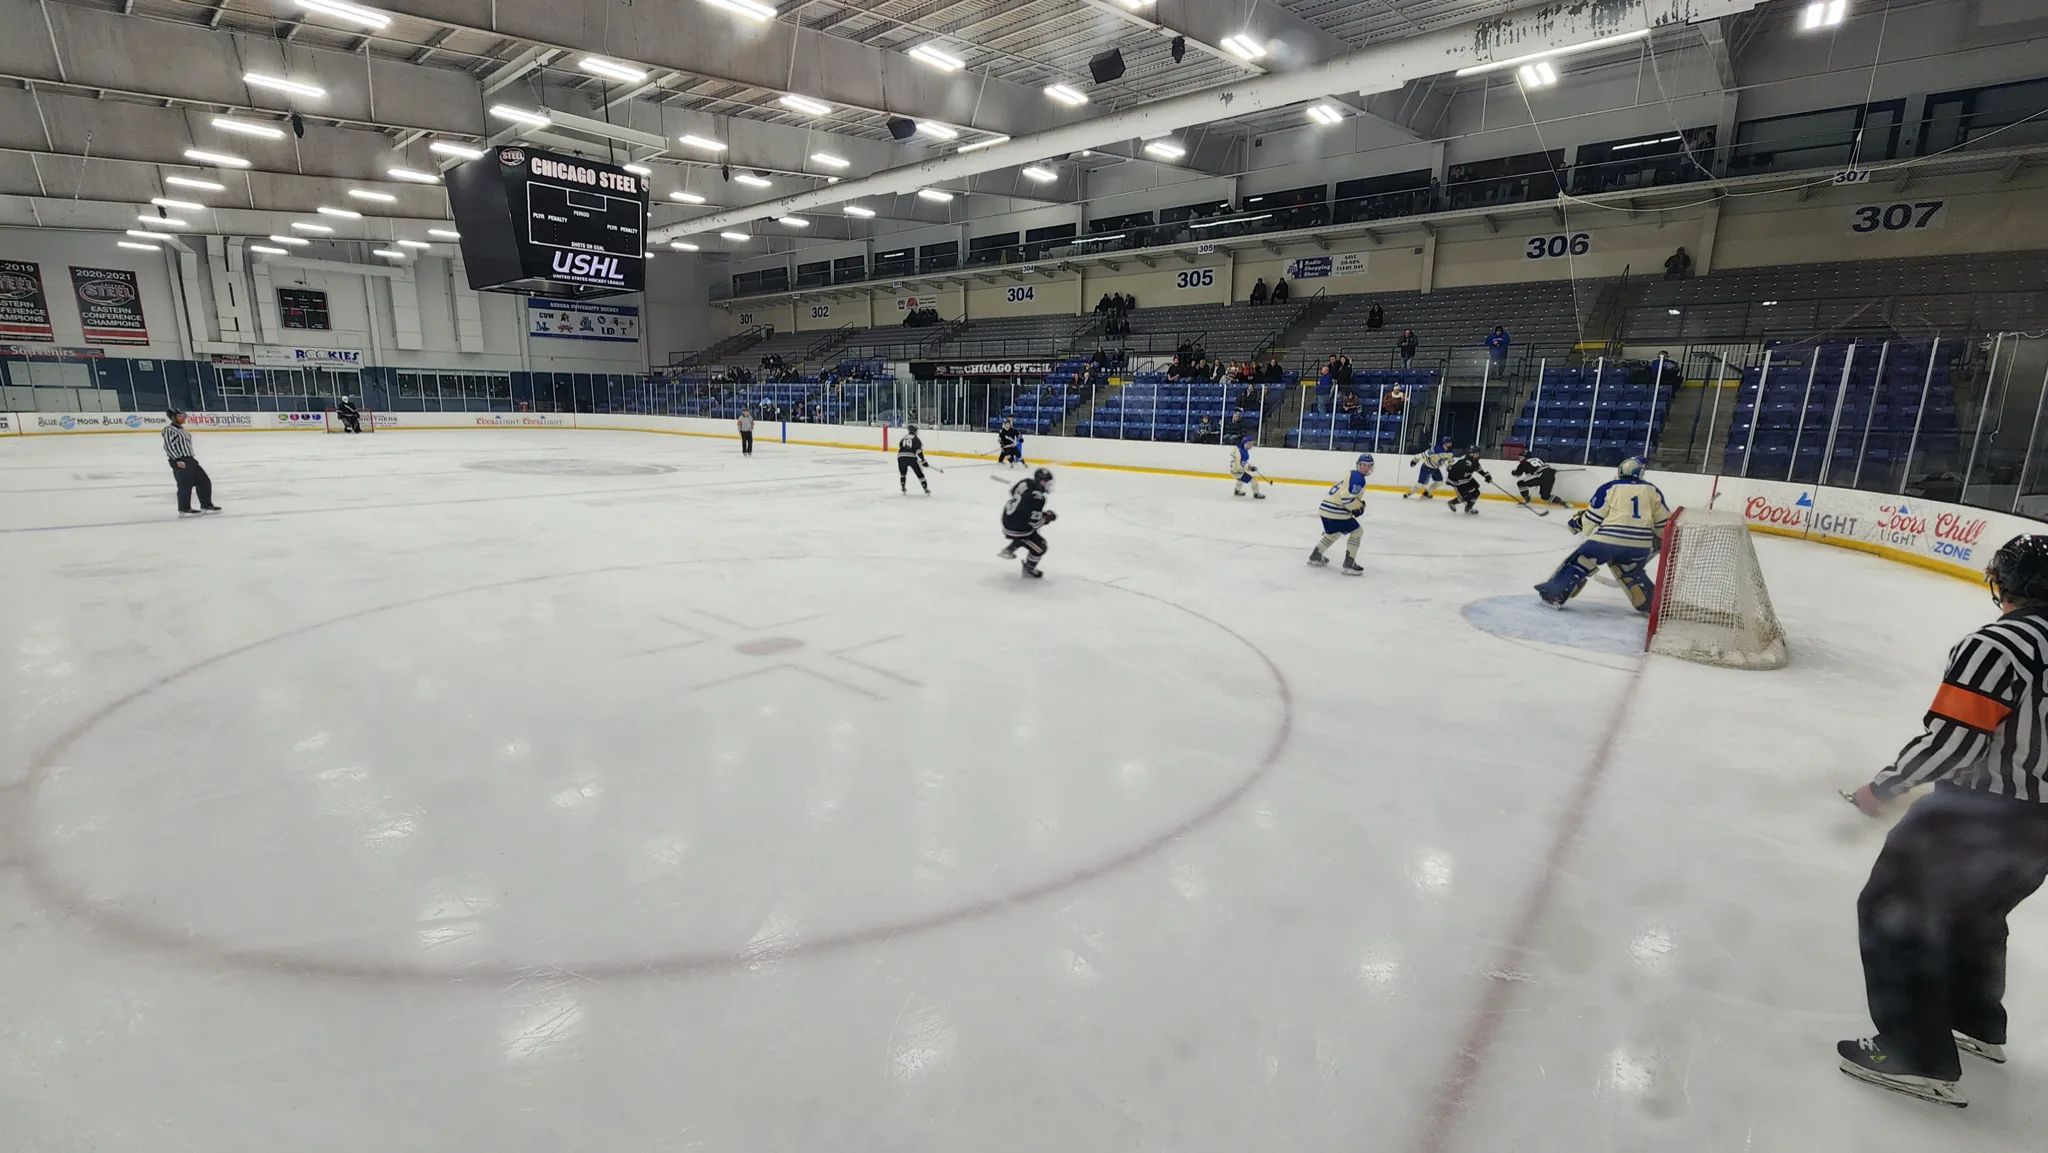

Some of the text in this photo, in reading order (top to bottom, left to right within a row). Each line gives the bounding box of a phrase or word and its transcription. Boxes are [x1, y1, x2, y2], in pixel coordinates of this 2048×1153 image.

[502, 150, 525, 160] STEEL
[531, 157, 638, 194] CHICAGO STEEL
[1835, 170, 1869, 183] 307
[547, 214, 568, 223] PENALTY
[573, 210, 590, 218] PERIOD
[1852, 201, 1943, 232] 307
[620, 226, 638, 234] PENALTY
[571, 241, 586, 249] SHOTS
[1526, 233, 1590, 259] 306
[552, 251, 624, 279] USHL
[75, 269, 131, 281] 2020-2021
[588, 276, 607, 284] HOCKEY
[1177, 269, 1214, 288] 305
[84, 284, 135, 299] STEEL
[1007, 286, 1034, 302] 304
[0, 300, 34, 308] STERN
[90, 305, 132, 314] EASTERN
[0, 307, 47, 316] FERENCE
[82, 312, 142, 321] CONFERENCE
[811, 306, 829, 318] 302
[87, 319, 141, 328] CHAMPIONS
[739, 313, 753, 325] 301
[10, 345, 76, 358] Souvenirs
[294, 349, 360, 361] ROOKIES
[963, 363, 1012, 374] CHICAGO
[1013, 363, 1052, 373] STEEL
[38, 416, 57, 426] BLUE
[102, 416, 123, 425] BLUE
[187, 413, 251, 427] alphagraphics
[1630, 495, 1641, 519] 1
[1745, 496, 1858, 536] Coors LIGHT
[1934, 512, 1987, 546] Chill
[1933, 541, 1973, 561] ZONE
